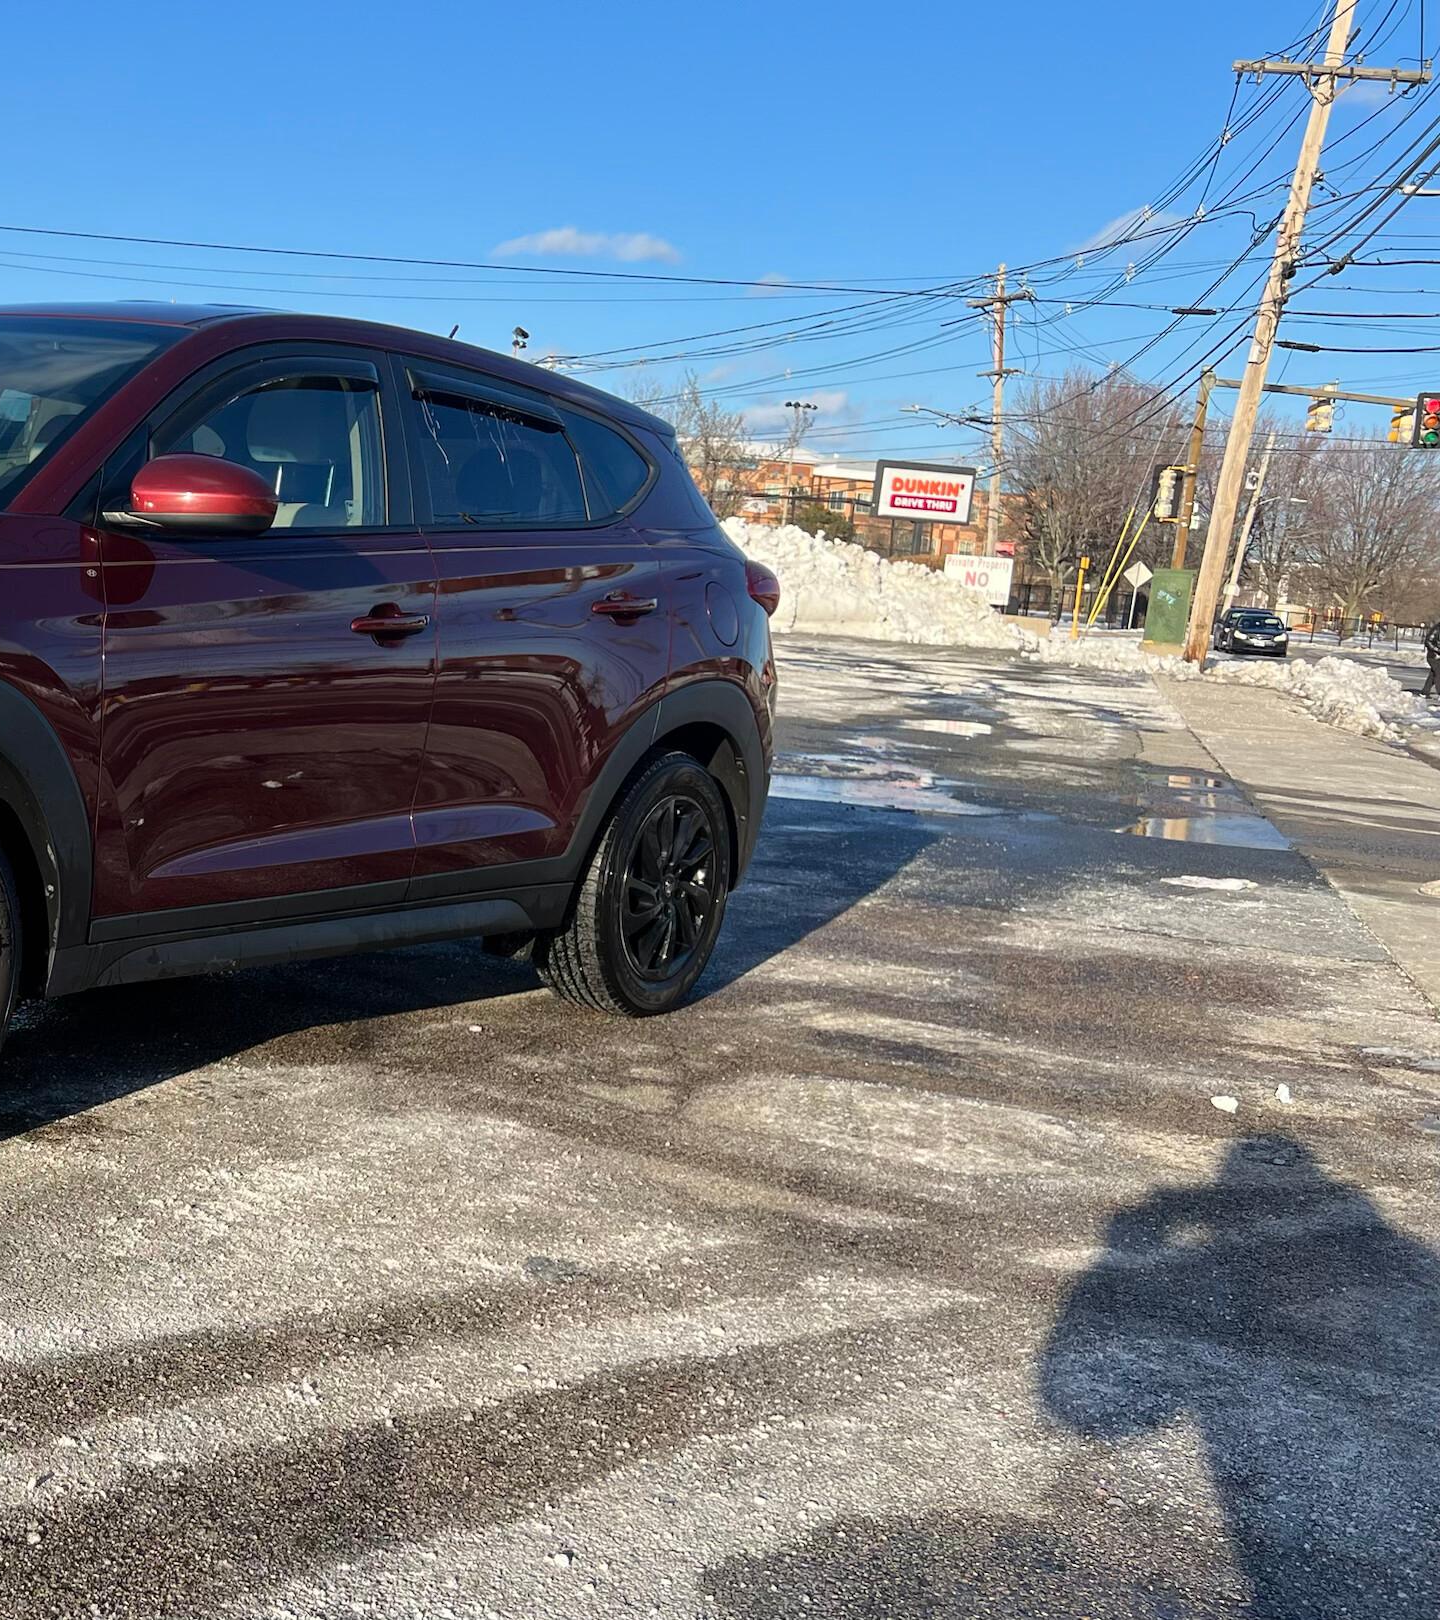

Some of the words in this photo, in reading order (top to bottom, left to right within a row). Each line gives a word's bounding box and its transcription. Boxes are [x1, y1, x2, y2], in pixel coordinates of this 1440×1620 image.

[891, 477, 965, 497] DUNKIN'
[894, 497, 924, 509] DRIVE
[926, 499, 954, 511] THRU
[947, 557, 975, 568] Private
[977, 559, 1009, 572] Property
[964, 571, 989, 587] NO
